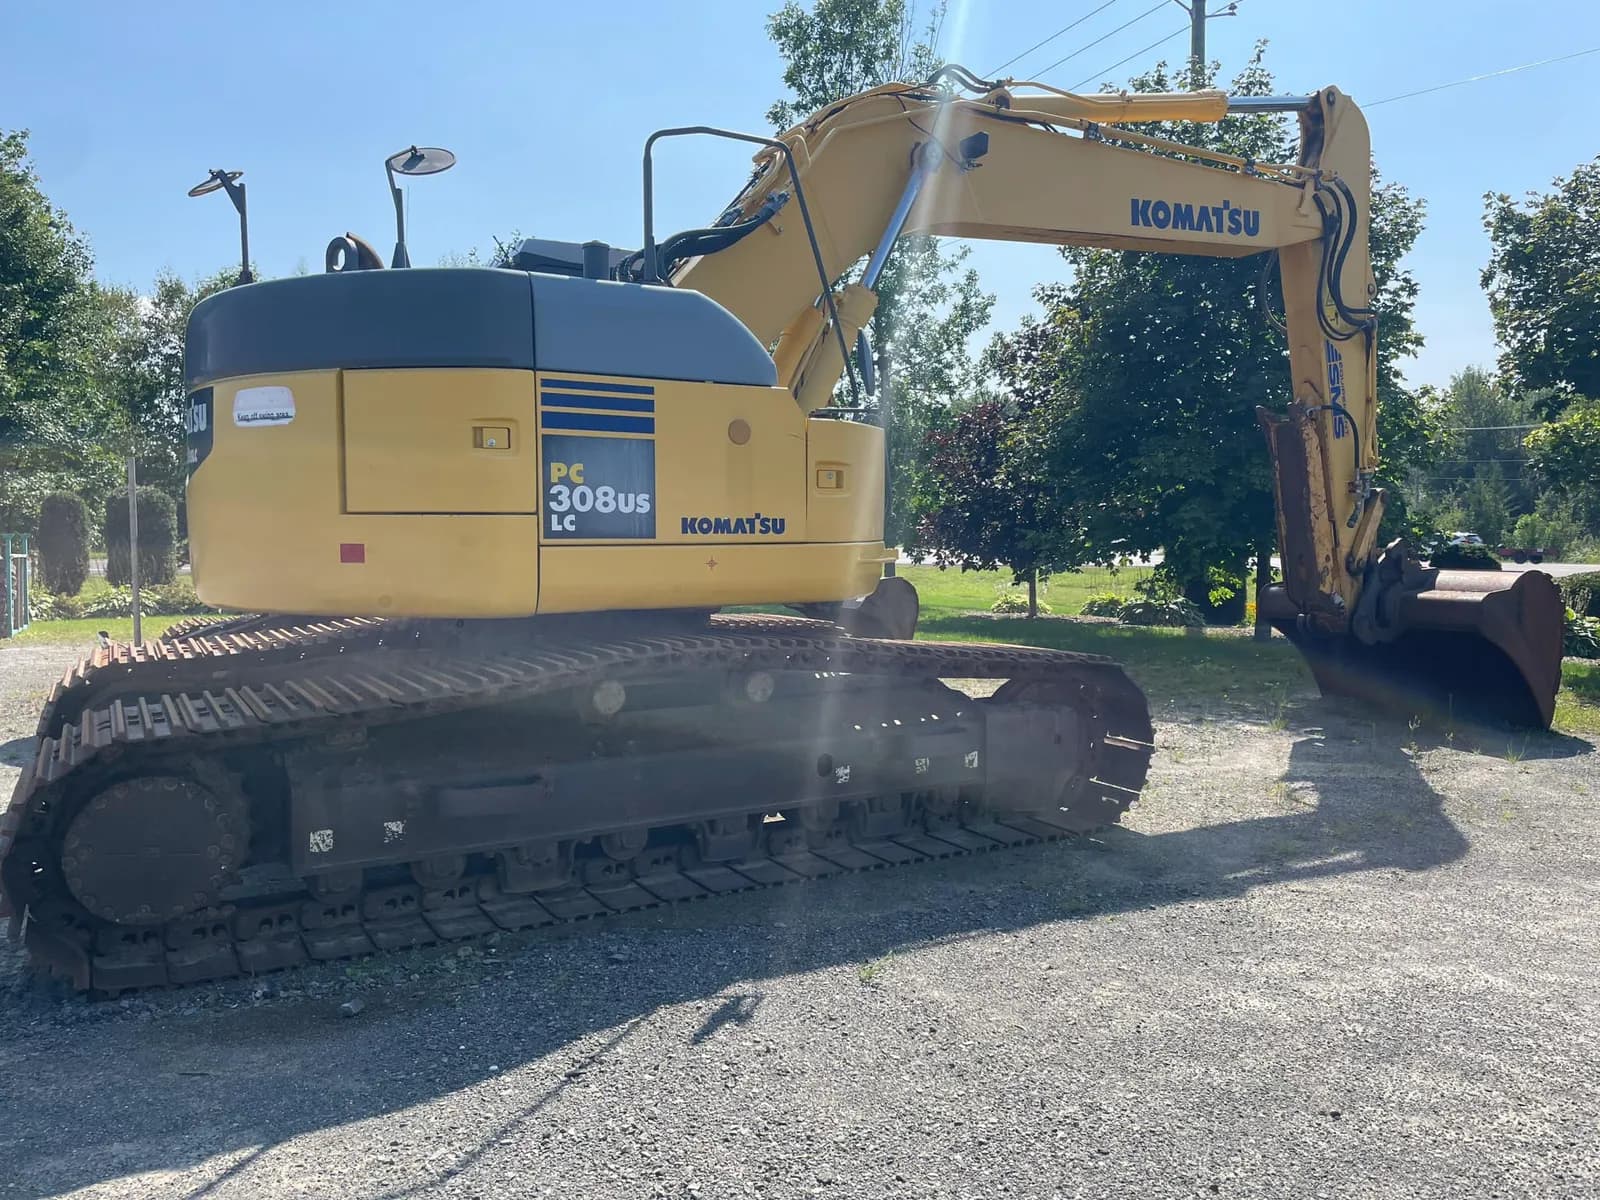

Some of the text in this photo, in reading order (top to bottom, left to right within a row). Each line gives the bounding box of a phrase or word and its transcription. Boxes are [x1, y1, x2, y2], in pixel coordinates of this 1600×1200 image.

[1130, 198, 1260, 237] KOMATSU
[550, 462, 584, 484] PC
[551, 514, 576, 531] LC
[681, 513, 786, 535] KOMATSU
